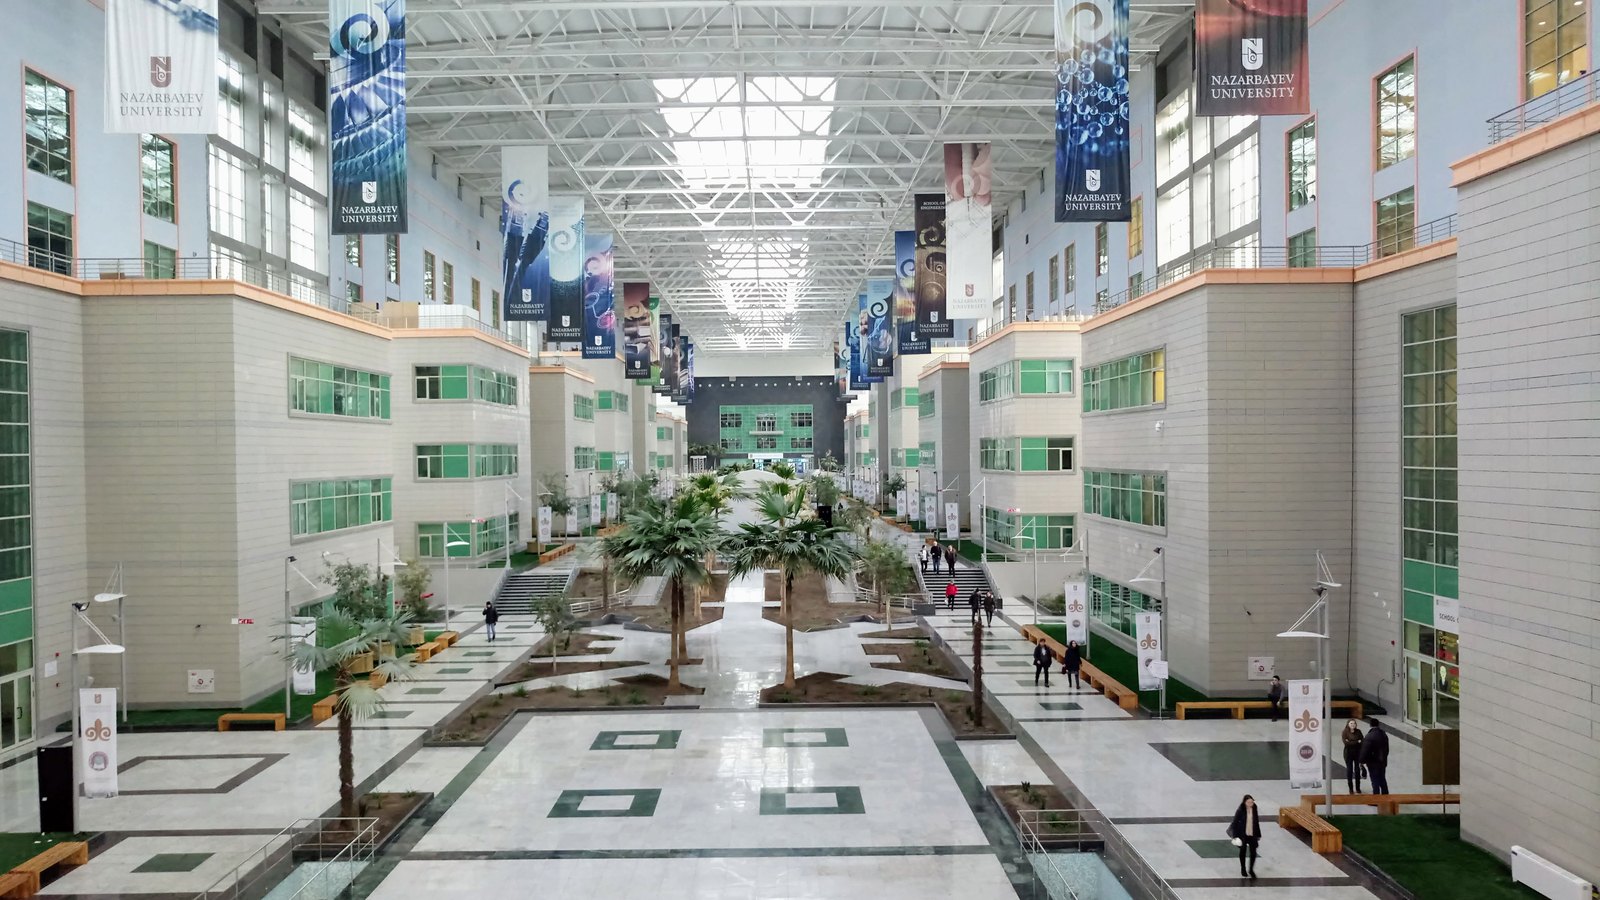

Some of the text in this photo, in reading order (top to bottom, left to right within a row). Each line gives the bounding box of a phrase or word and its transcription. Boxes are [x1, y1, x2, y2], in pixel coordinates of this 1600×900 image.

[1211, 74, 1295, 85] NAZARBAYEV
[120, 92, 204, 103] NAZARBAYEV
[1211, 87, 1295, 98] UNIVERSITY
[120, 106, 203, 116] UNIVERSITY
[1065, 194, 1122, 202] NAZARBAYEV
[1065, 202, 1122, 210] UNIVERSITY
[1439, 612, 1455, 622] SCHOOL
